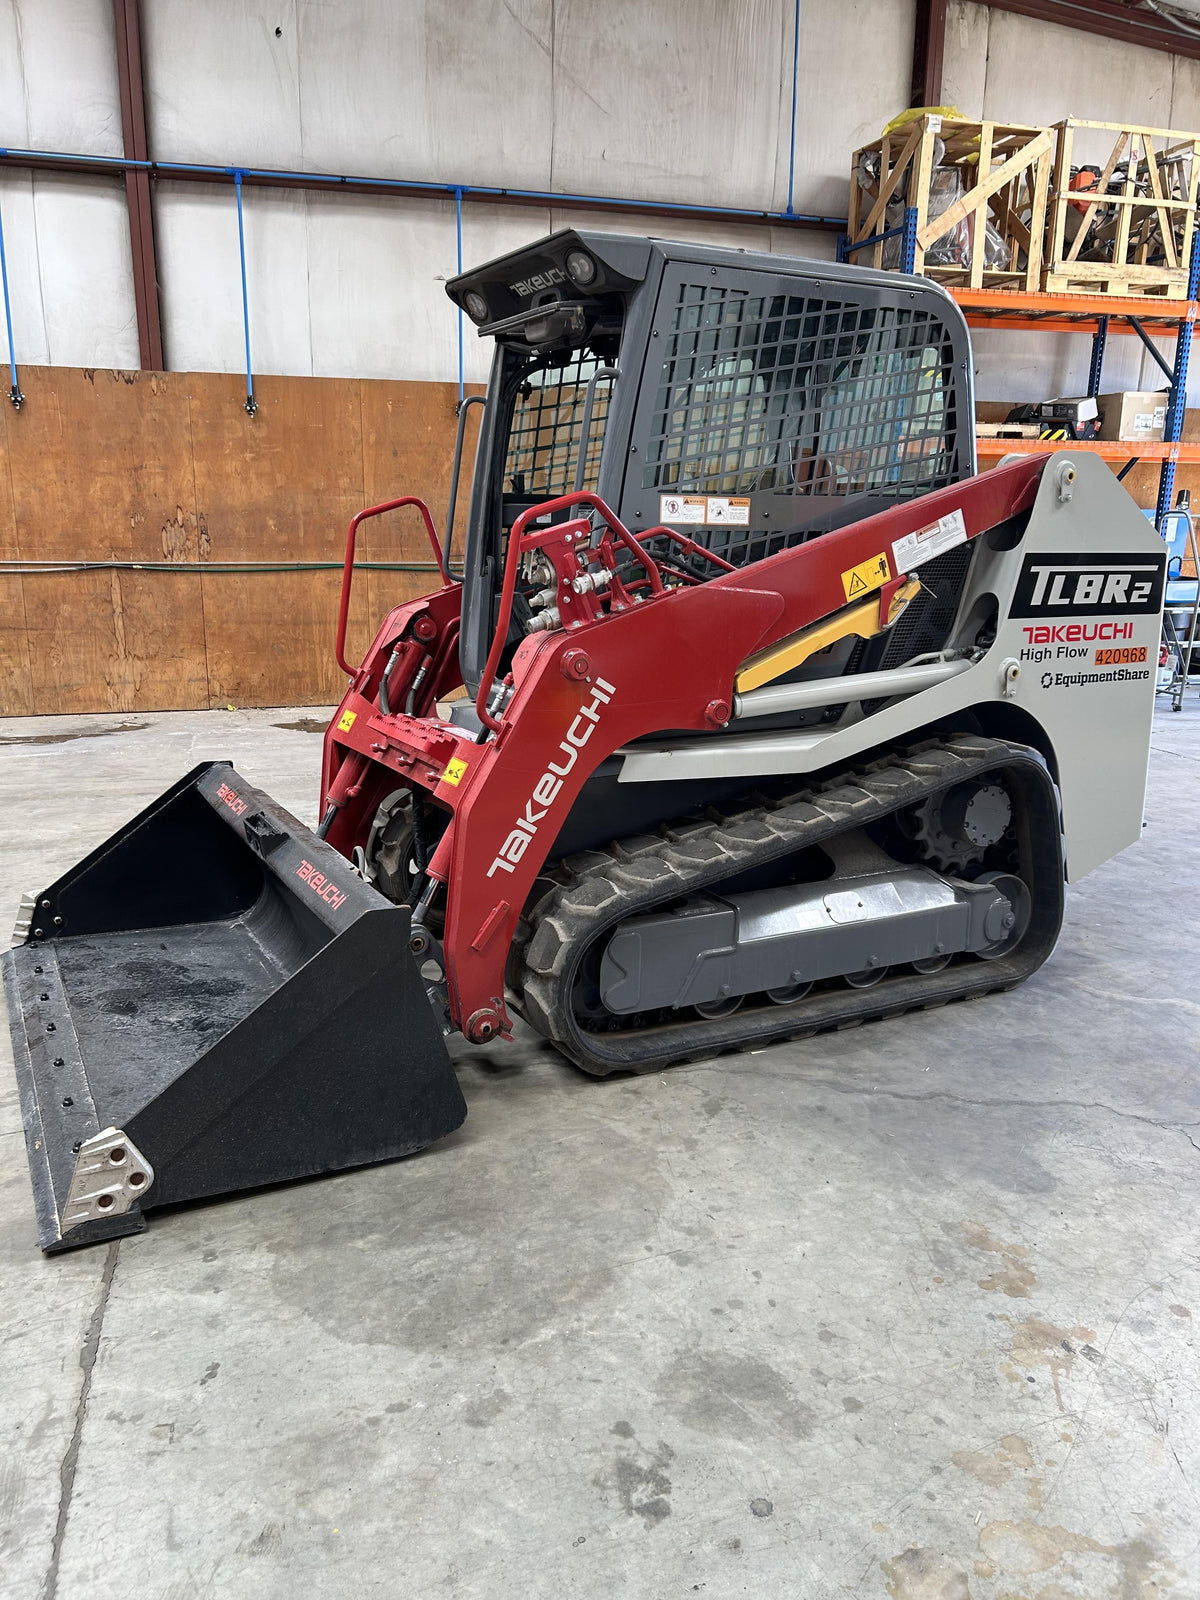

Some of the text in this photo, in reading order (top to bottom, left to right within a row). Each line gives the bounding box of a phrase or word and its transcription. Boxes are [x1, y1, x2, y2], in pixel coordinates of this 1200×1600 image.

[509, 267, 566, 297] TAKEUCH
[1029, 564, 1160, 606] TL8R2
[1022, 622, 1133, 644] TAKEUCHI
[1020, 646, 1088, 663] High Flow
[1095, 646, 1147, 665] 420968
[1054, 668, 1150, 688] EquipmentShare
[486, 677, 617, 878] TAKEUCHI
[215, 782, 248, 816] TAKEUCHI
[295, 859, 347, 911] TAKEUCHI
